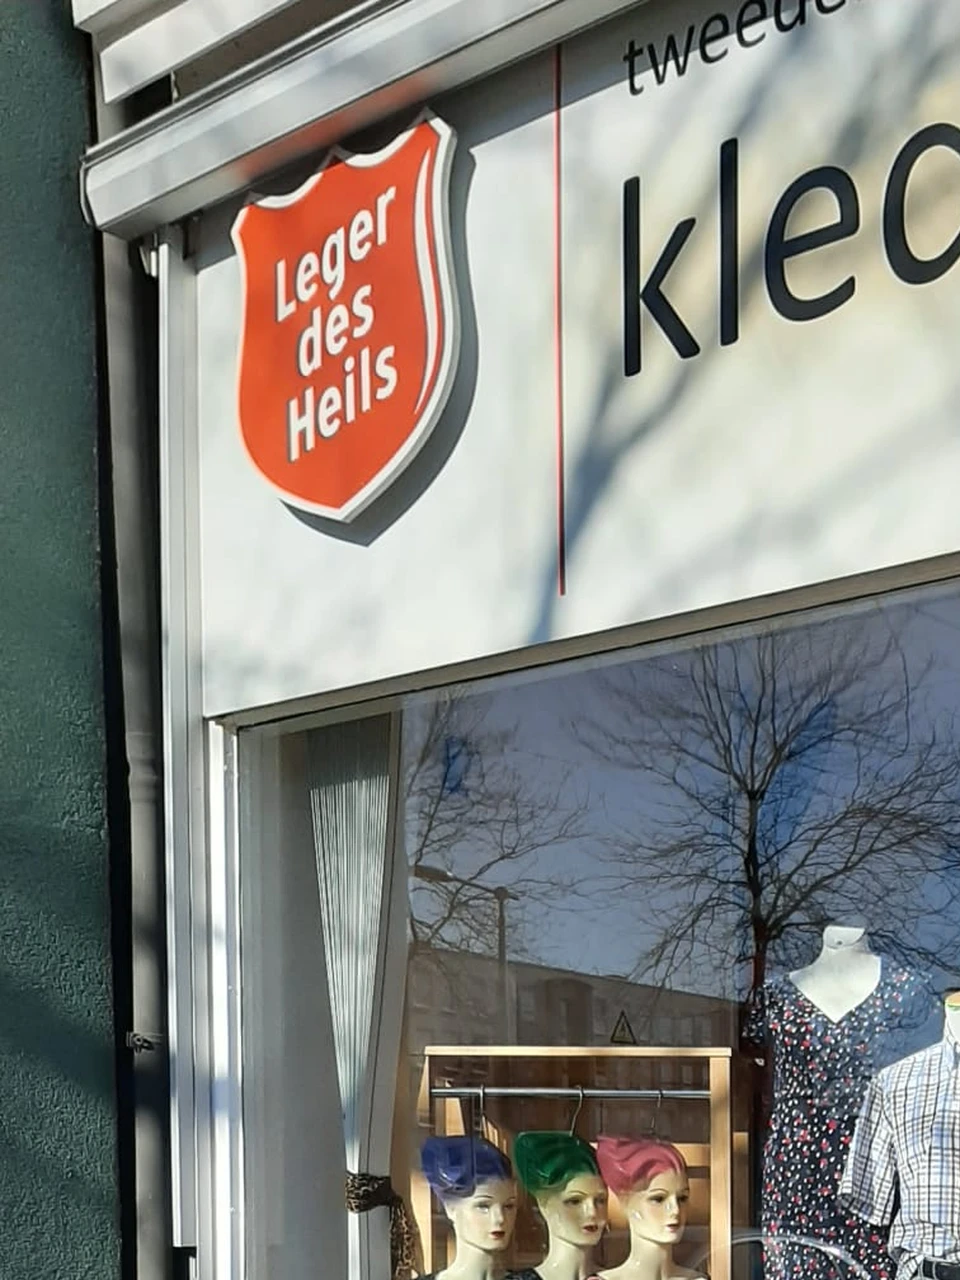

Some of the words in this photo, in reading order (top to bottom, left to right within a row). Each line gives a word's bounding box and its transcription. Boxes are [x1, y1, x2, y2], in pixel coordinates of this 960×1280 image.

[623, 0, 847, 95] twee
[275, 186, 396, 323] Leger
[298, 284, 374, 377] des
[287, 345, 398, 463] Heils
